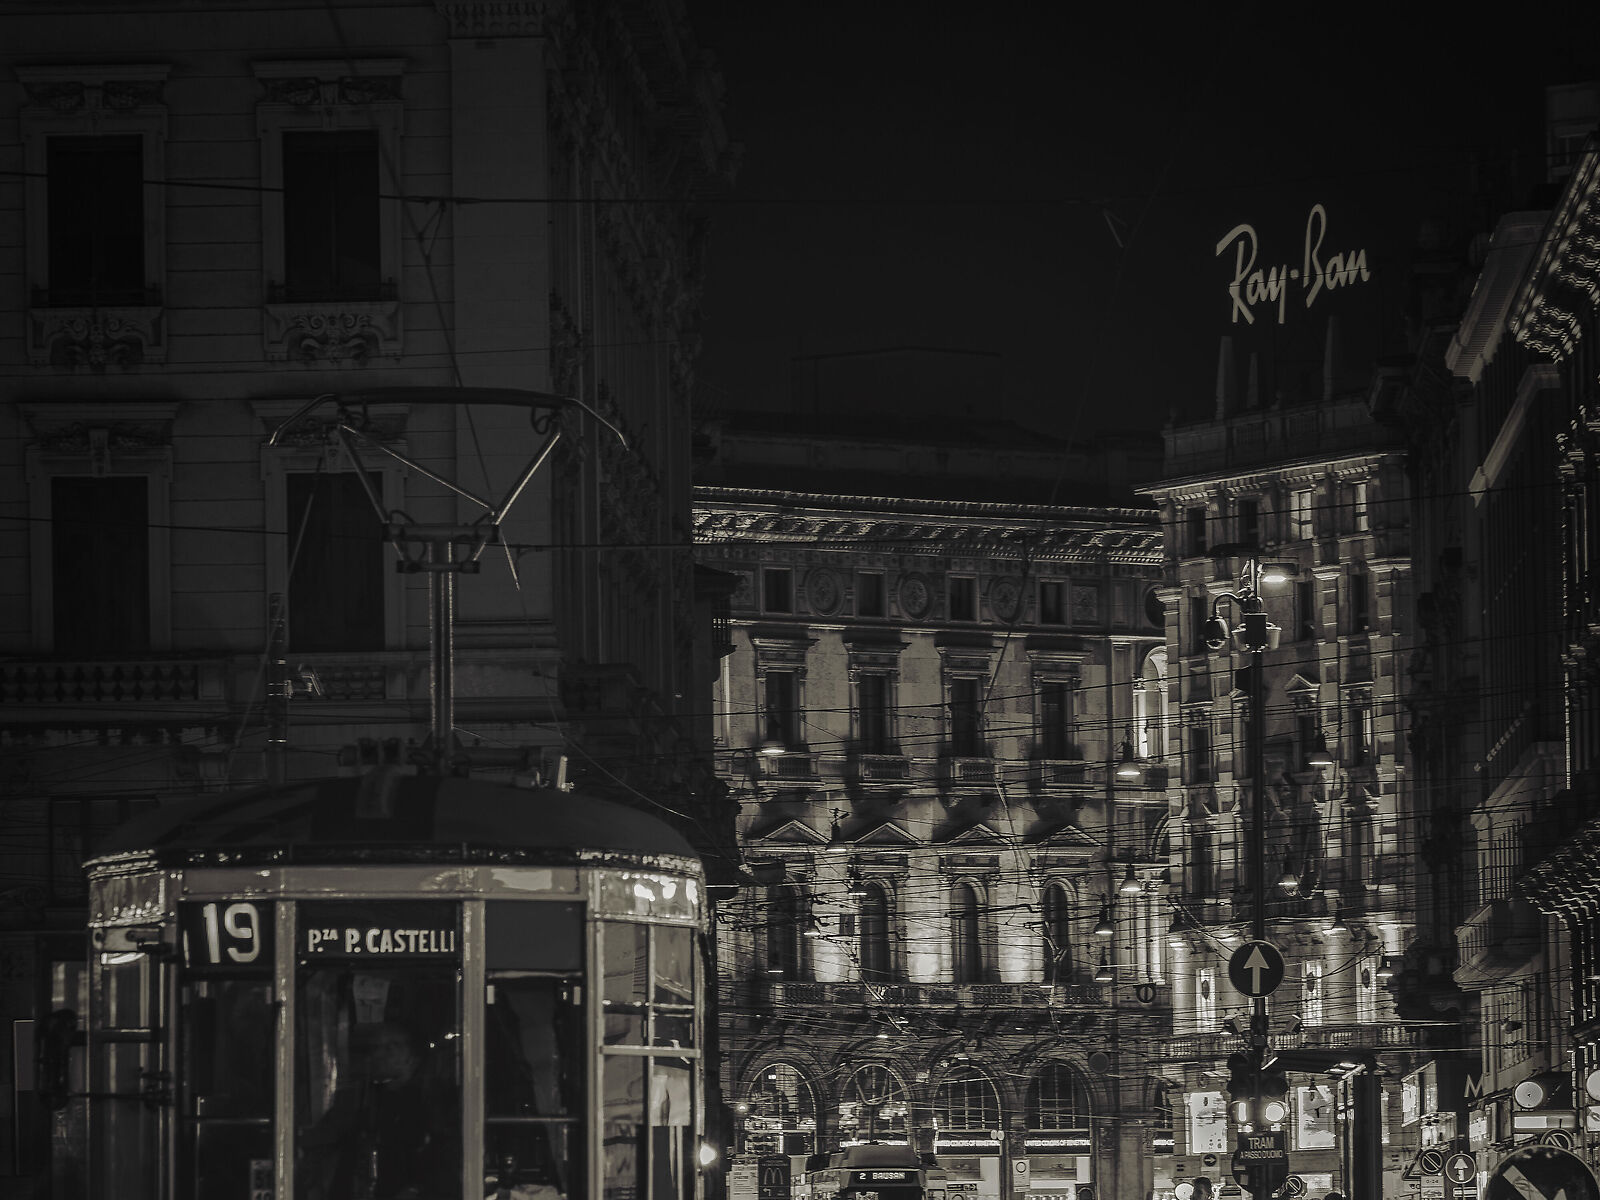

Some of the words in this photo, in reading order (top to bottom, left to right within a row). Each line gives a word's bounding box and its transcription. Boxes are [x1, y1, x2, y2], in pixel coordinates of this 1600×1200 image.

[1216, 203, 1371, 324] Ray-Ban
[203, 903, 260, 963] 19
[1248, 1137, 1275, 1149] TRAM
[860, 1172, 866, 1180] 2
